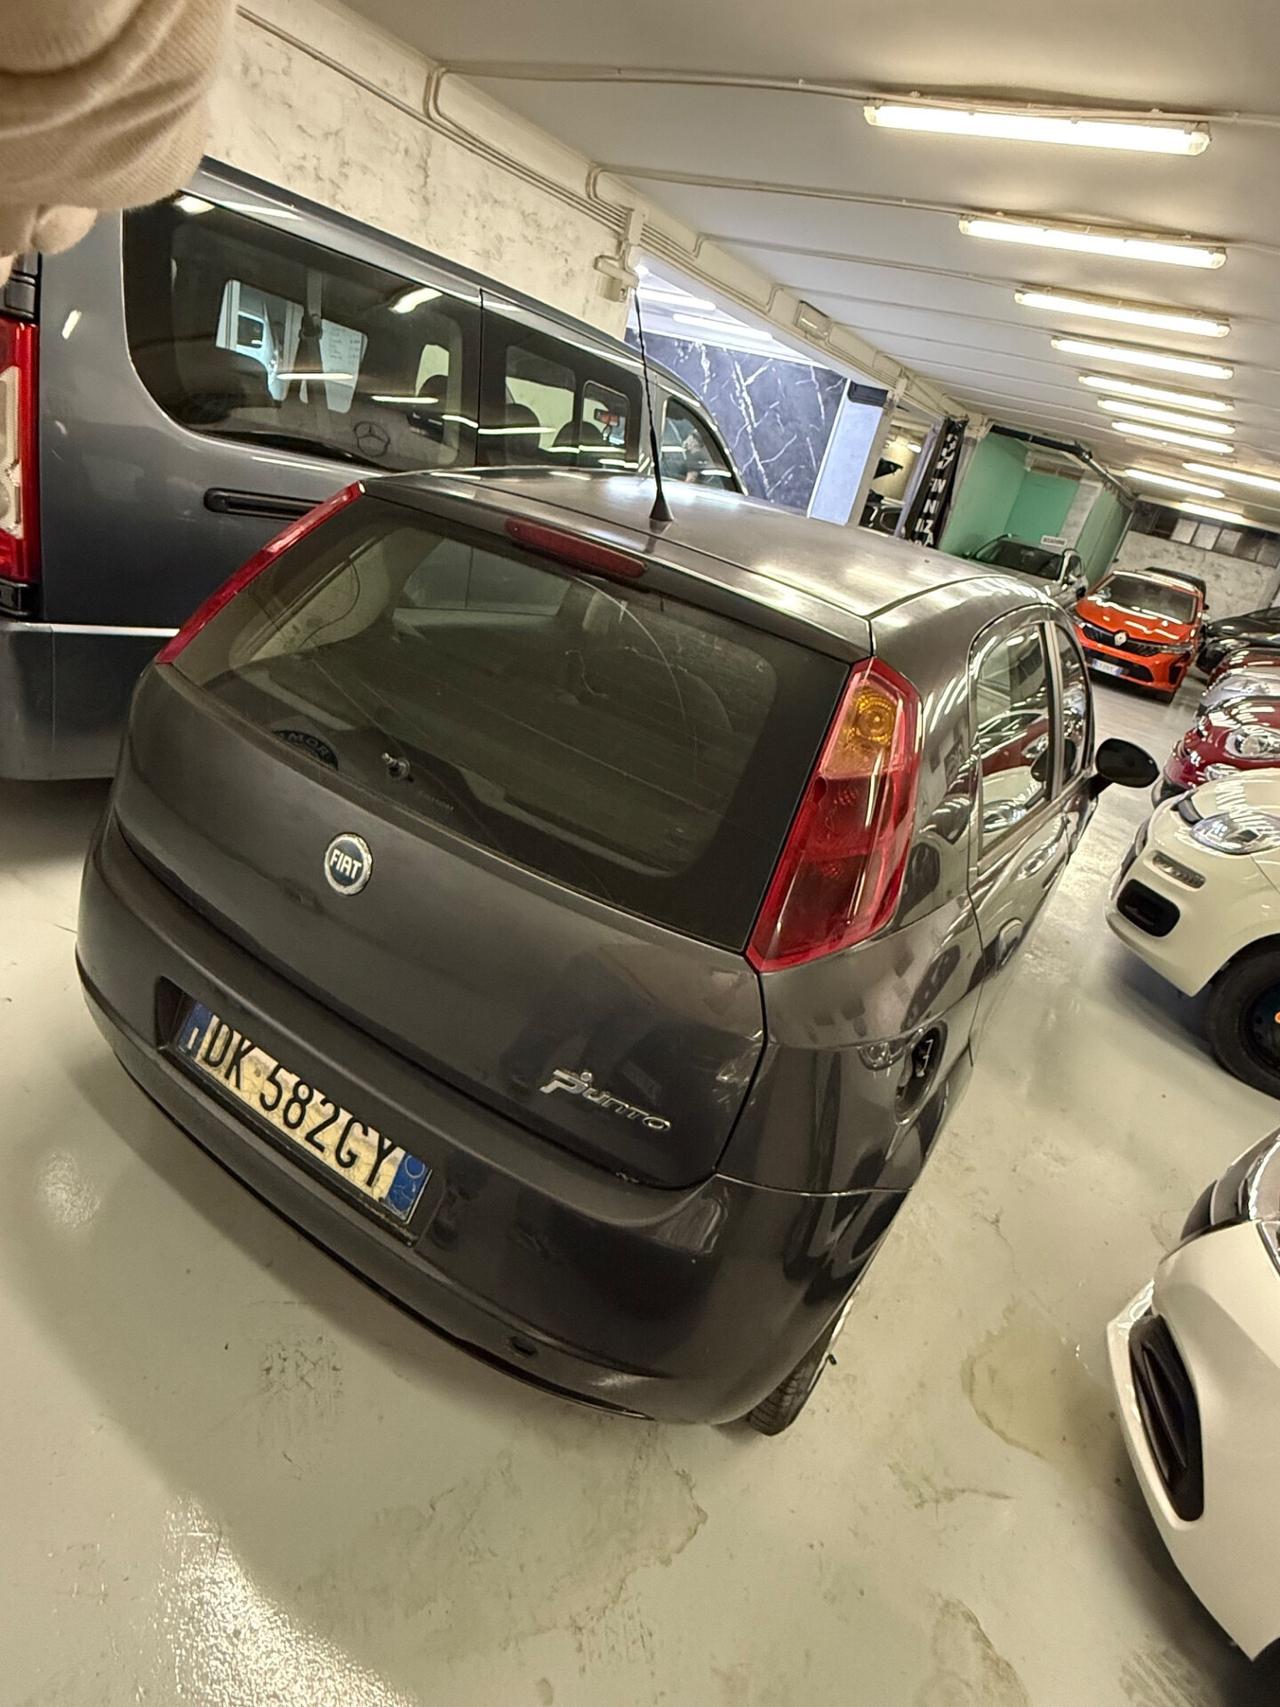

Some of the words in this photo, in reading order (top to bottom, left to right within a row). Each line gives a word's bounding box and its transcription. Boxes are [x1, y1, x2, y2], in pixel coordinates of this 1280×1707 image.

[330, 848, 362, 879] FIAT
[202, 1017, 250, 1089] DK
[259, 1062, 398, 1187] 582GY
[539, 1069, 671, 1132] Punto
